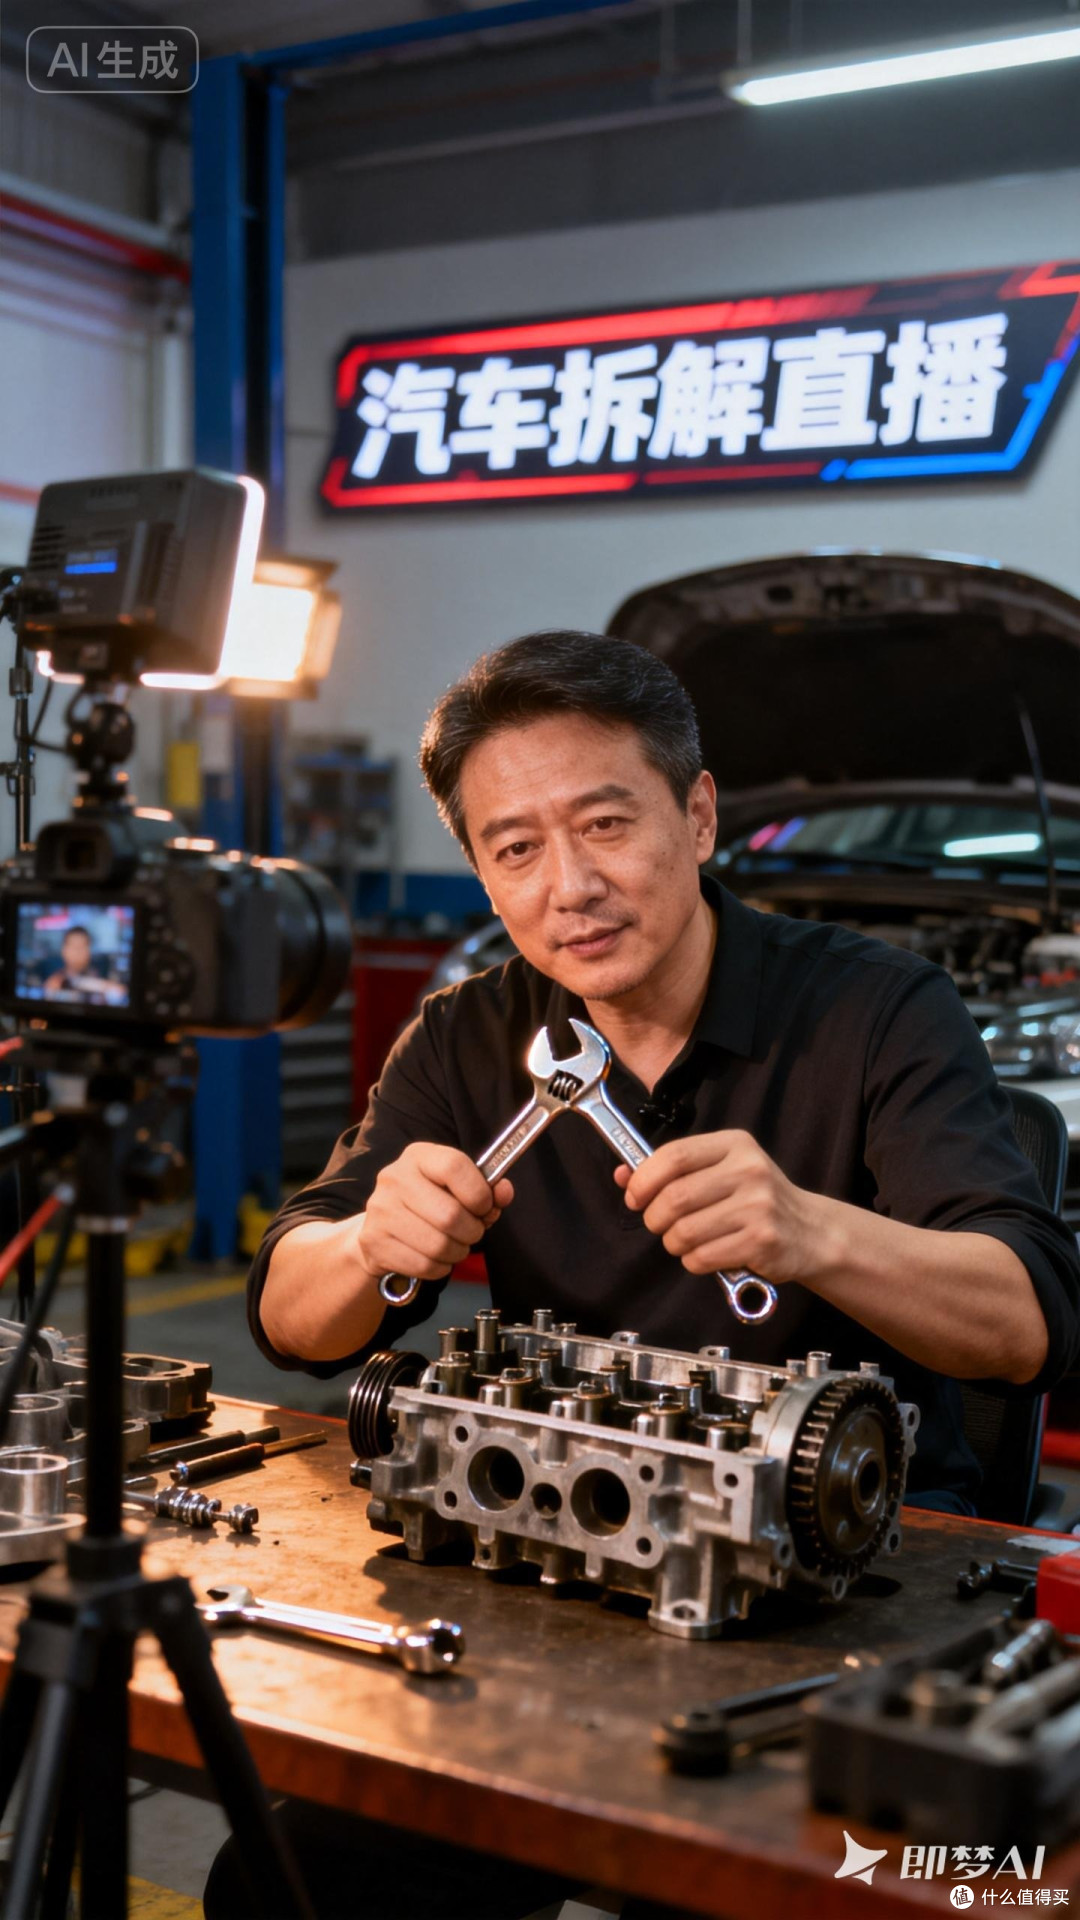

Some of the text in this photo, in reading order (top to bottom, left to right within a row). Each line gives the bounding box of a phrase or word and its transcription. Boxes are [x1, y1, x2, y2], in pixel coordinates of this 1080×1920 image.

[351, 312, 1009, 479] 汽车拆解直播
